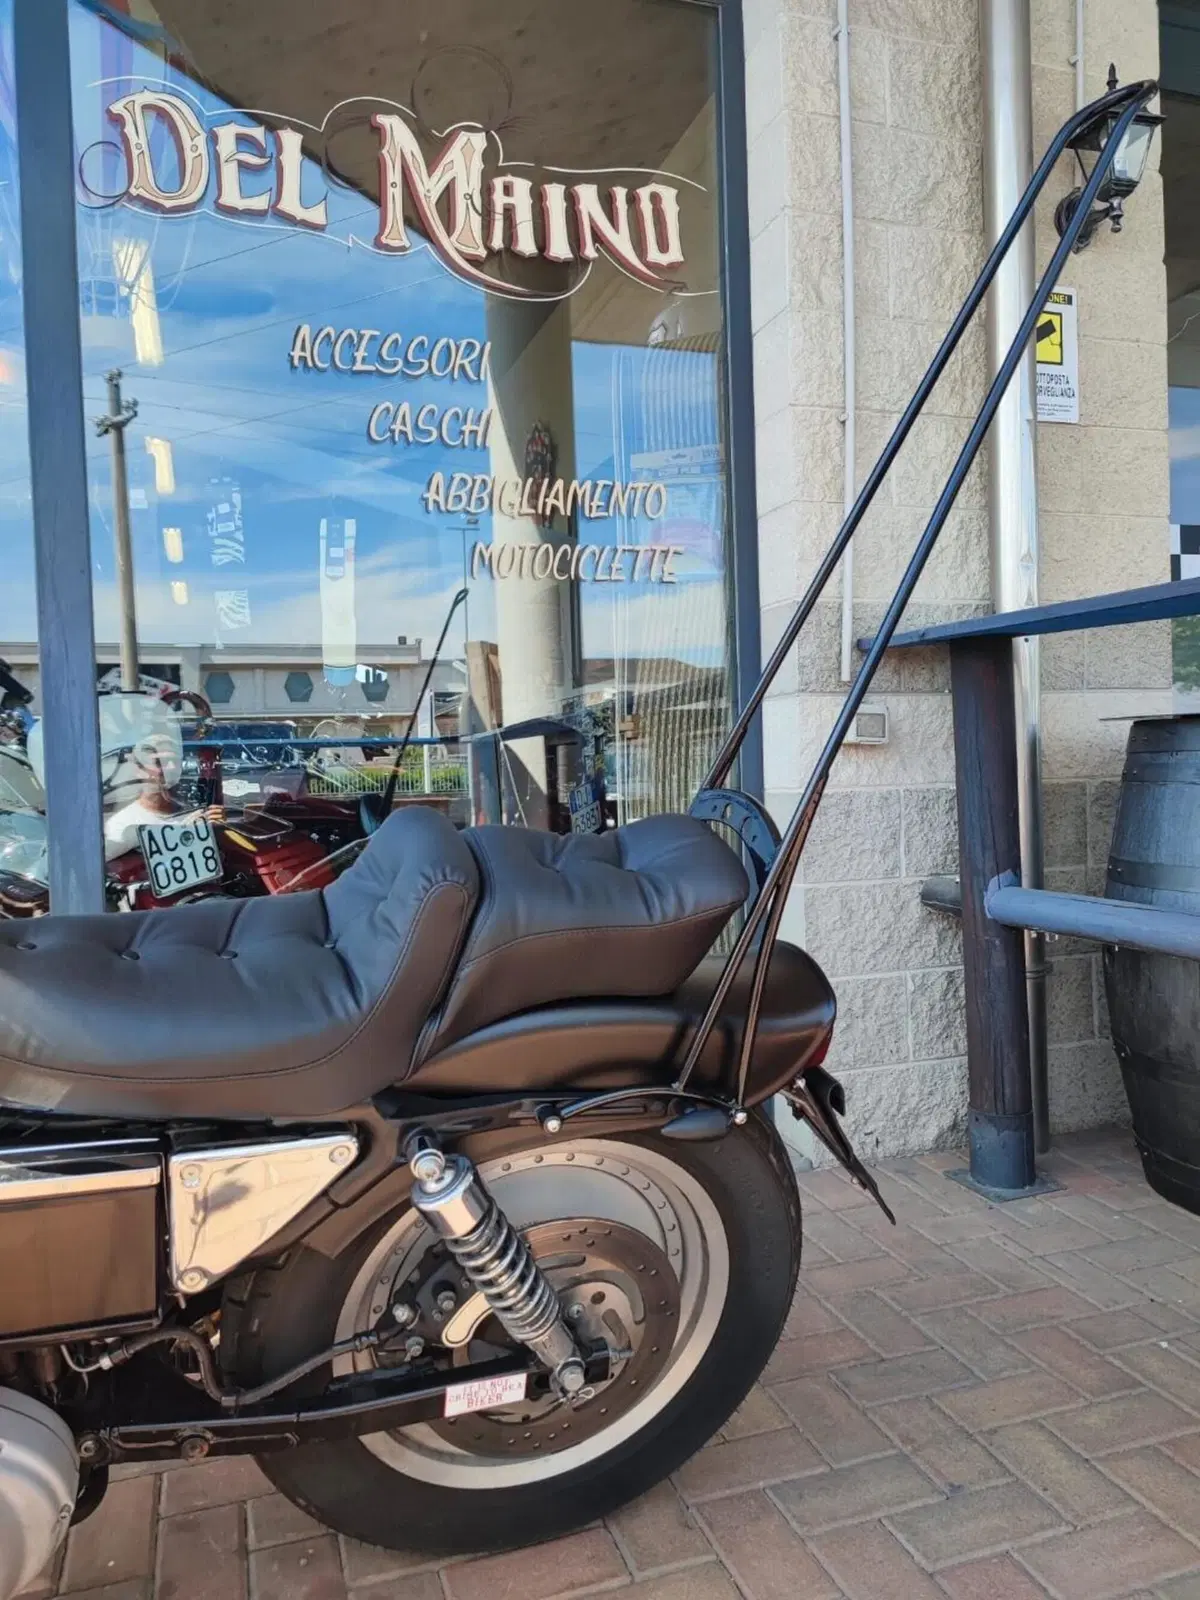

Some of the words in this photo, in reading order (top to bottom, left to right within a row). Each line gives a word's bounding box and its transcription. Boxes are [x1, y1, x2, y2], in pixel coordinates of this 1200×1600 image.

[290, 324, 491, 382] ACCESSORI
[368, 401, 492, 448] CASCHI
[423, 472, 667, 519] ABBIGLIAMENTO
[471, 541, 684, 583] MOTOCICLETTE
[147, 825, 179, 858] AC
[153, 846, 218, 889] 0818
